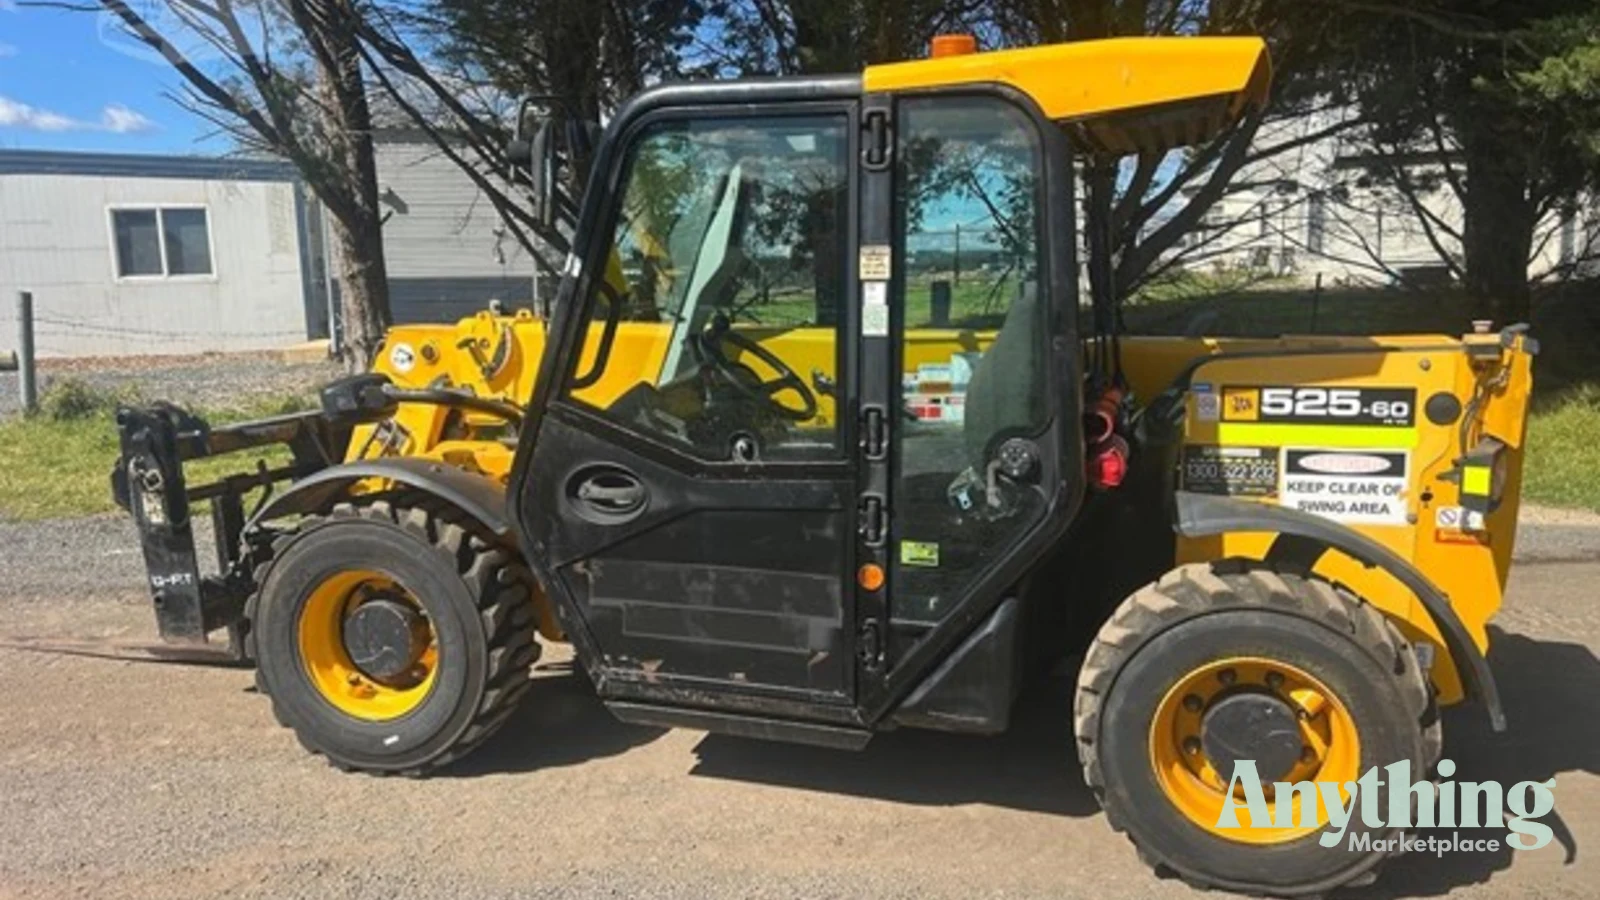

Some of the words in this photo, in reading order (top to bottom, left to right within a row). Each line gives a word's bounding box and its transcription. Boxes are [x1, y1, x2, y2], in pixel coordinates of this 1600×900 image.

[1261, 388, 1409, 418] 525-60
[1287, 481, 1325, 493] KEEP
[1328, 482, 1379, 495] CLEAR
[1298, 500, 1345, 514] SWING
[1349, 502, 1390, 515] AREA
